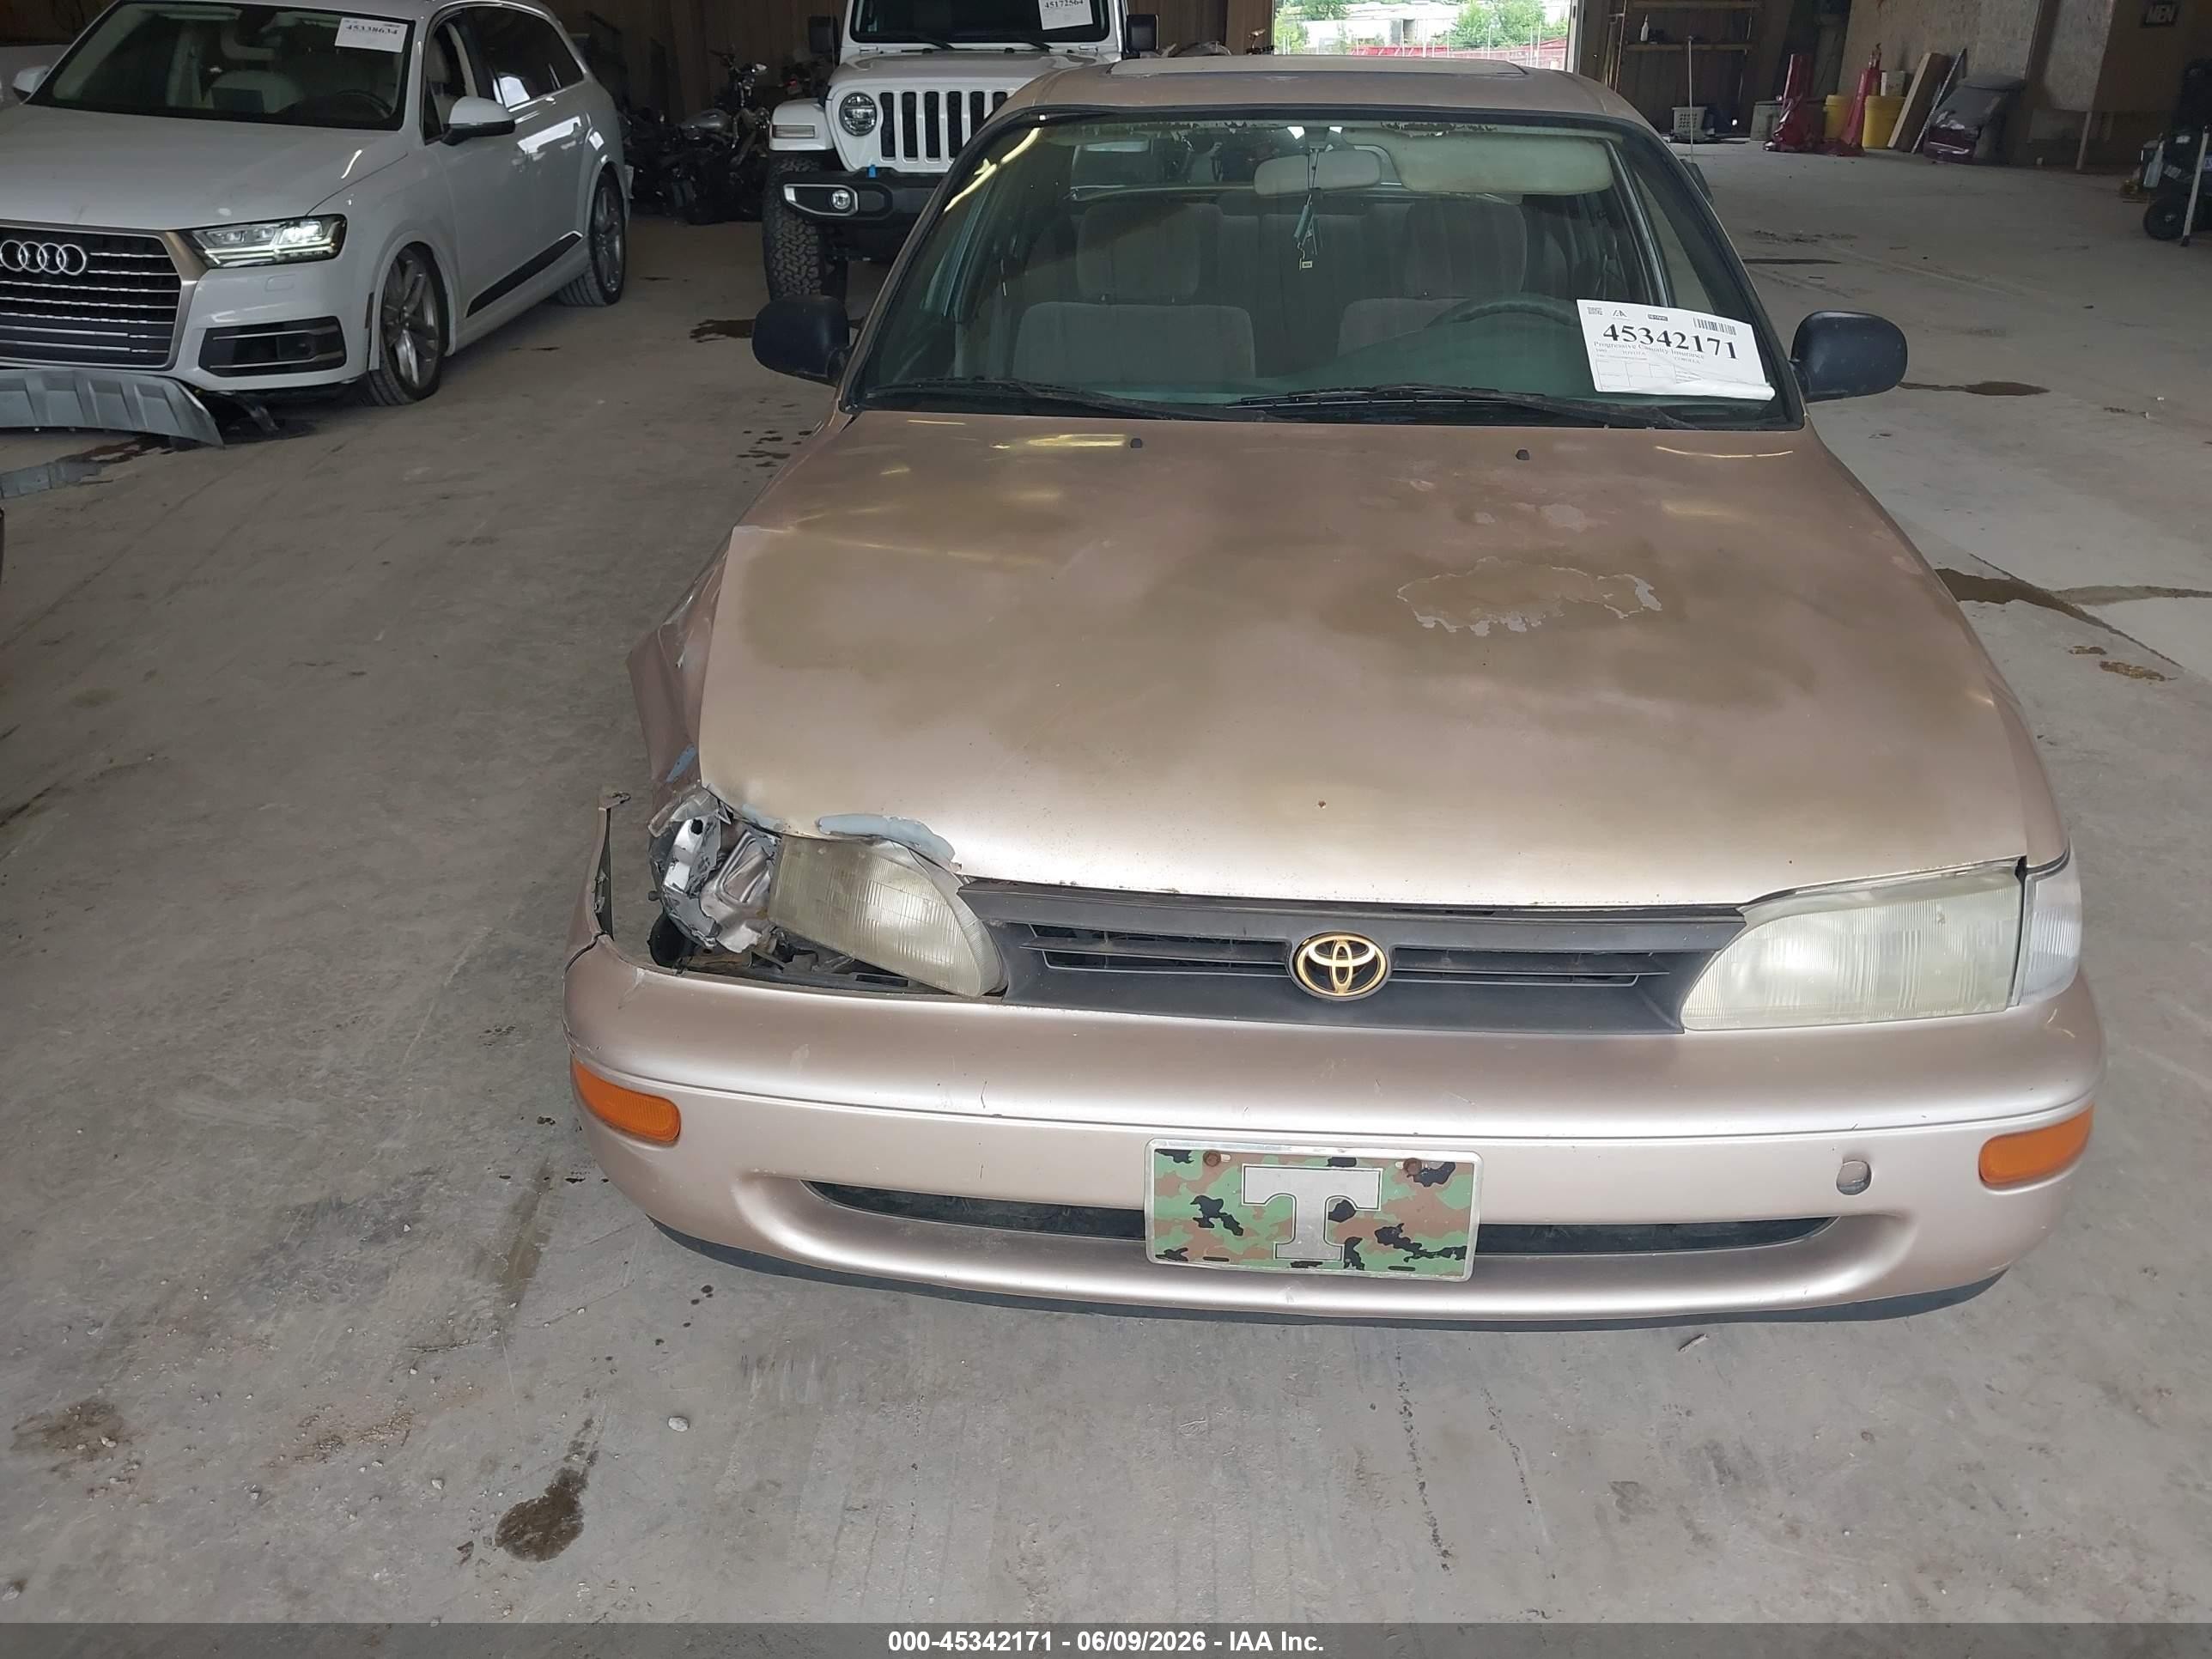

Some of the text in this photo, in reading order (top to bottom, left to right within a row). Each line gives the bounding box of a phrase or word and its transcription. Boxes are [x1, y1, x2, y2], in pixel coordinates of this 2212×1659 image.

[1594, 341, 1705, 360] Progressive Casualty Insurance
[1603, 324, 1740, 360] 45342171
[1241, 1164, 1384, 1261] T
